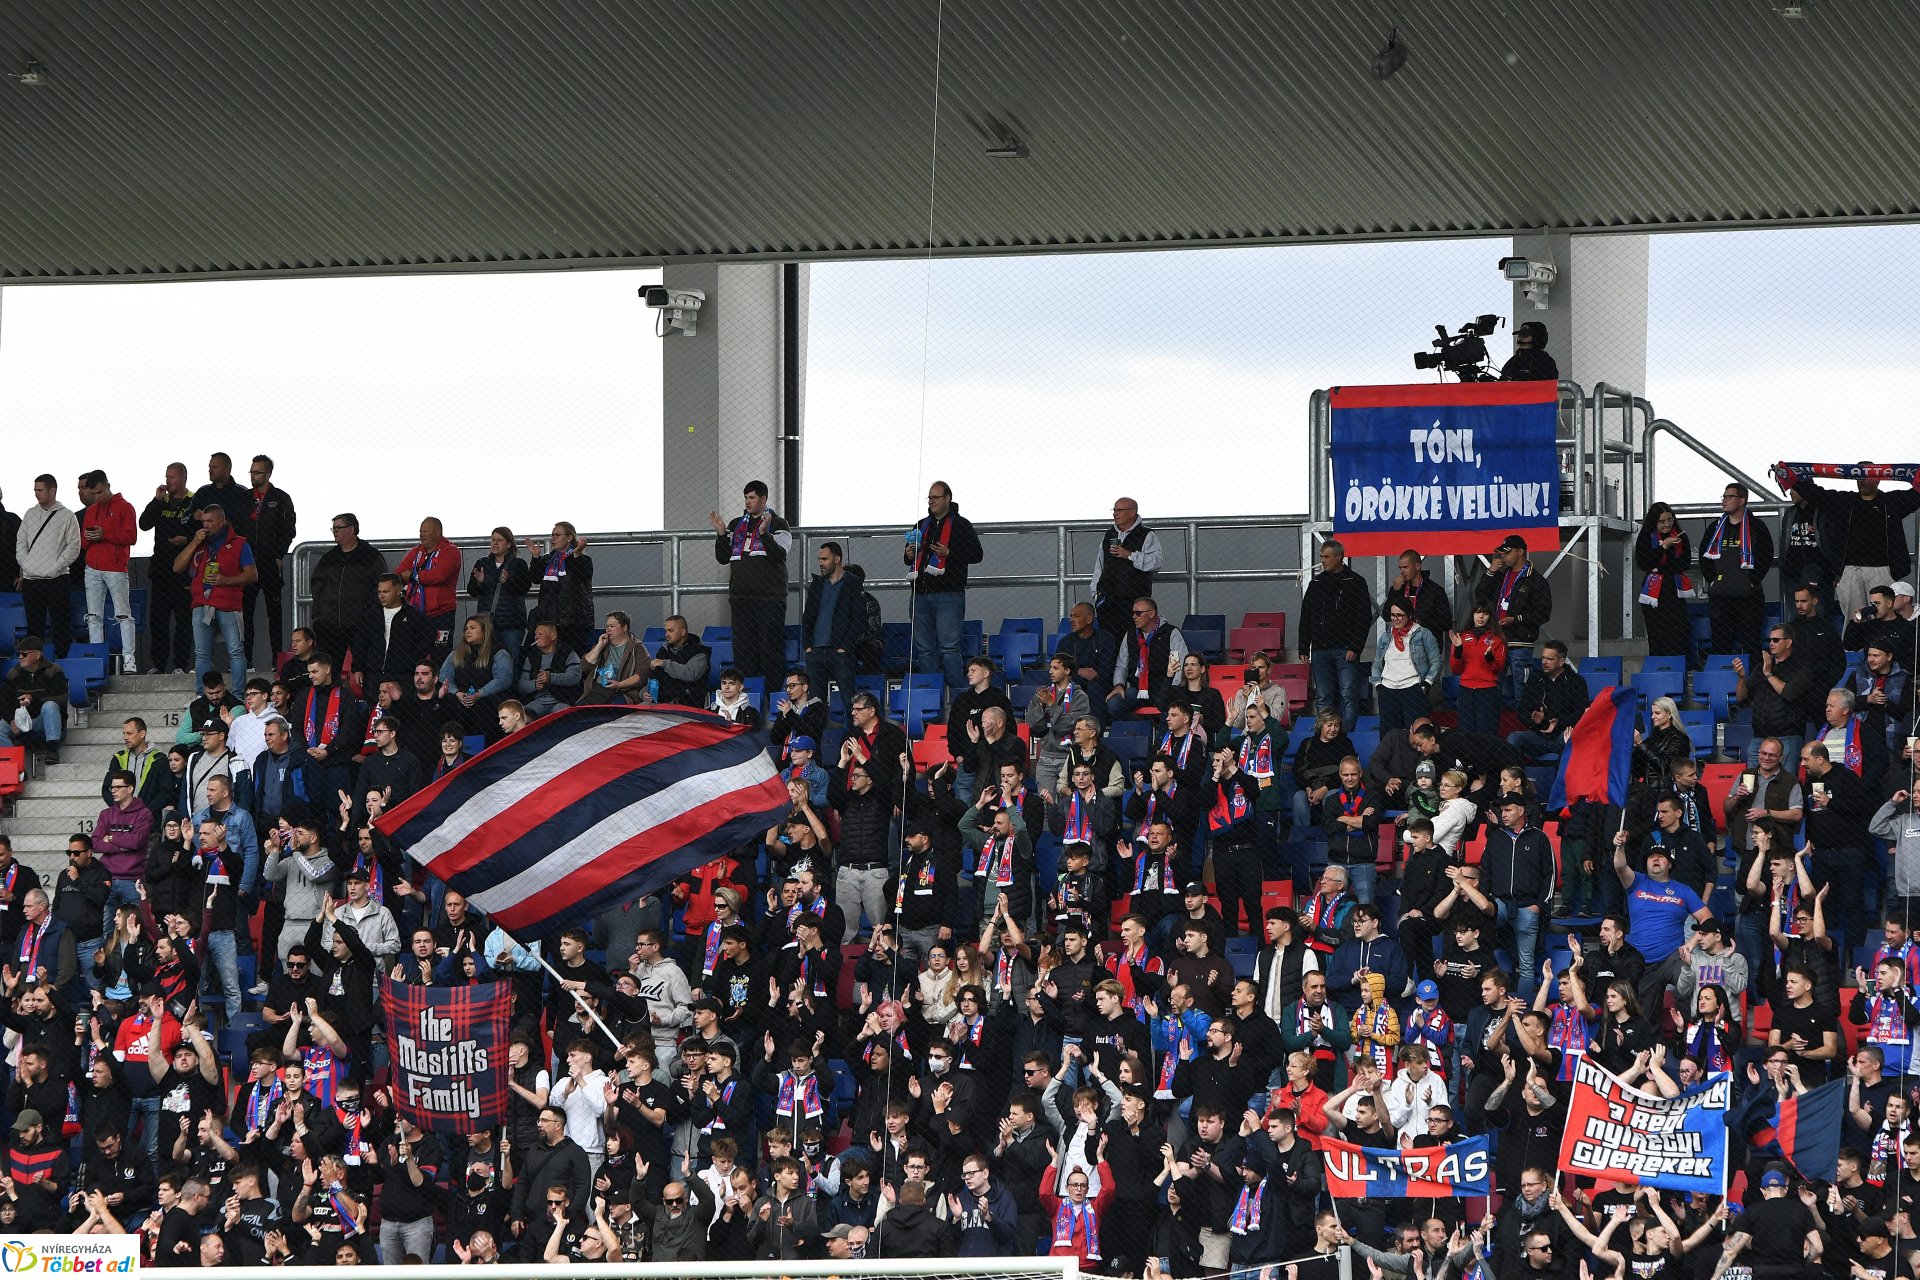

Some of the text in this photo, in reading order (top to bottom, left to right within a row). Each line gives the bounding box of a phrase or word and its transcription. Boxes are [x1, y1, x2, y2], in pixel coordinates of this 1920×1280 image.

[1410, 419, 1482, 469] TÓNI,
[1850, 466, 1918, 479] ATTACK
[1345, 475, 1551, 522] ÖRÖKKÉ VELÜNK!
[163, 713, 179, 726] 15
[78, 820, 94, 833] 13
[420, 1006, 452, 1042] the
[398, 1035, 488, 1075] Mastiffs
[407, 1073, 480, 1119] Family
[1324, 1151, 1489, 1183] ULTRAS
